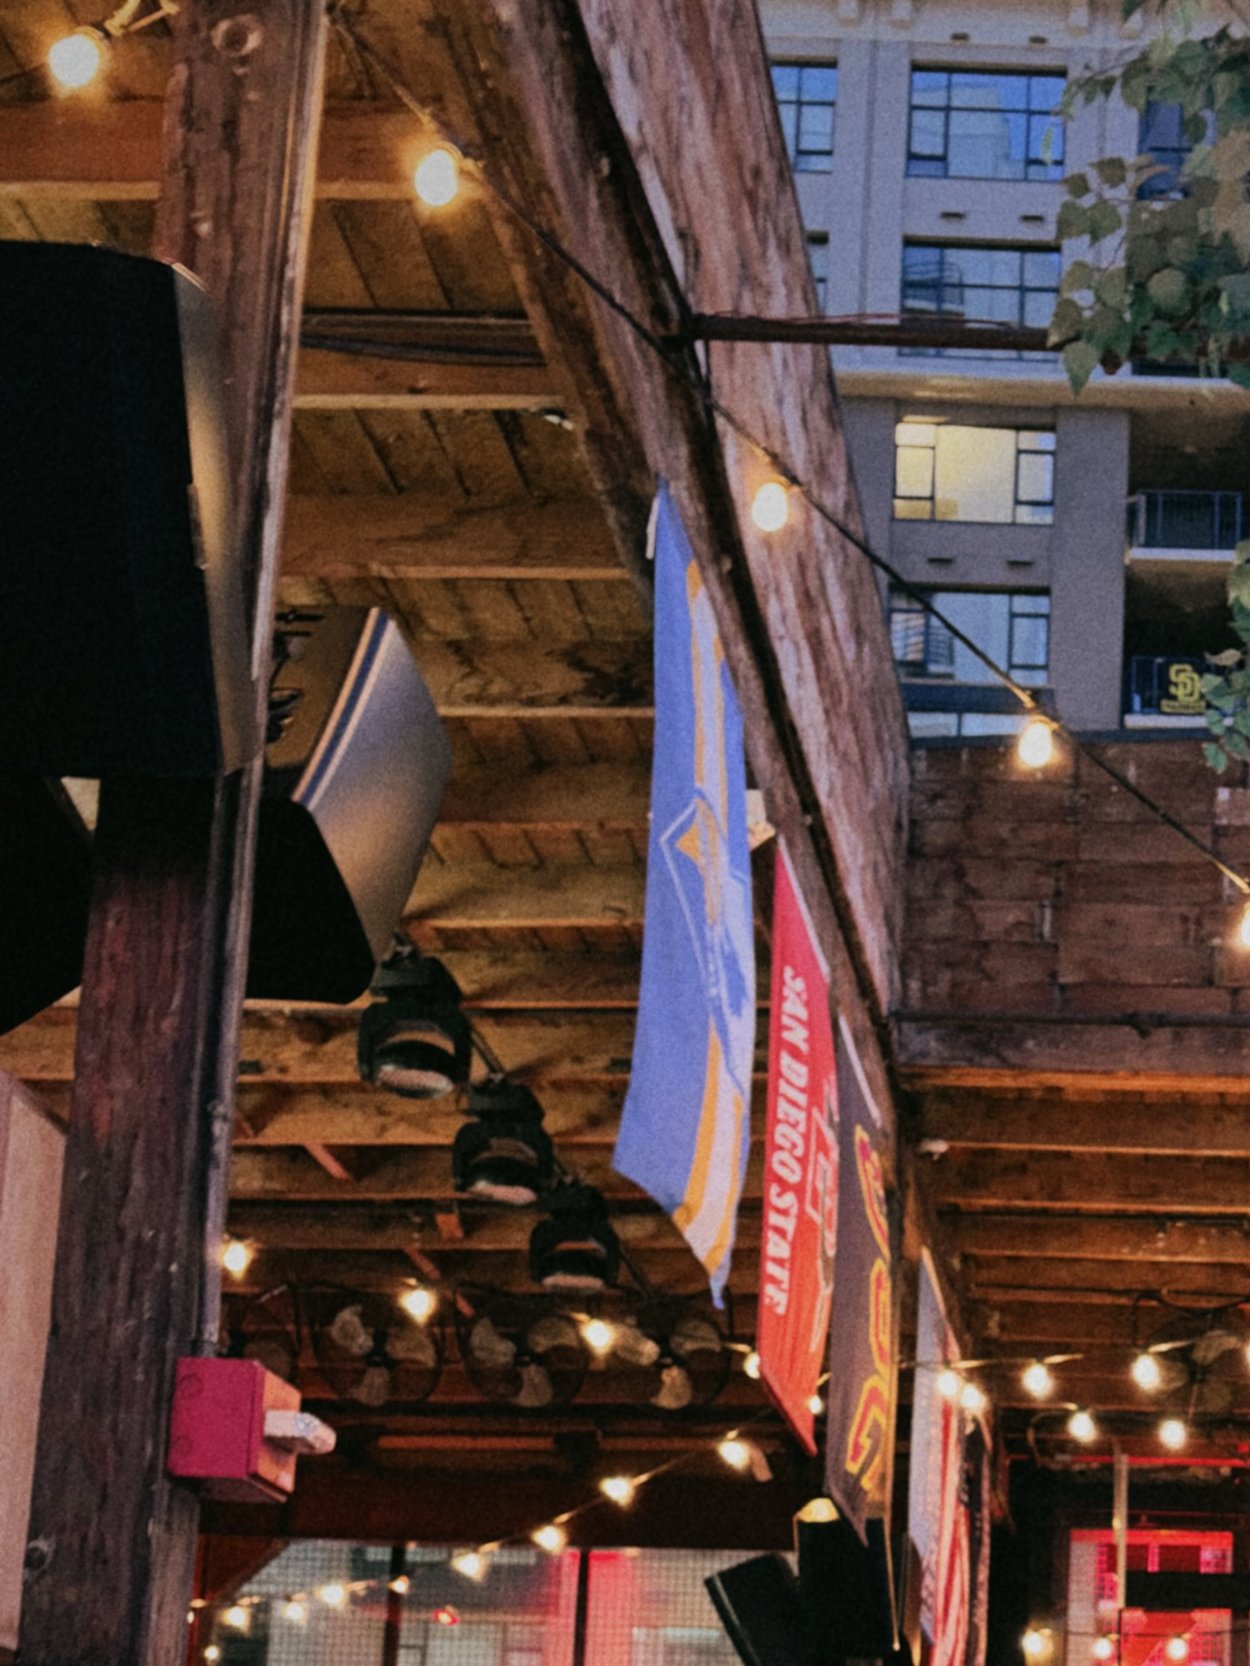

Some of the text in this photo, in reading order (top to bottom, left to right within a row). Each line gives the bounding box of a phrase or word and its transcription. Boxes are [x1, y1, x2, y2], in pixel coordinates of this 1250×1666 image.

[1168, 663, 1201, 702] SD
[764, 964, 811, 1317] SAN DIEGO STATE
